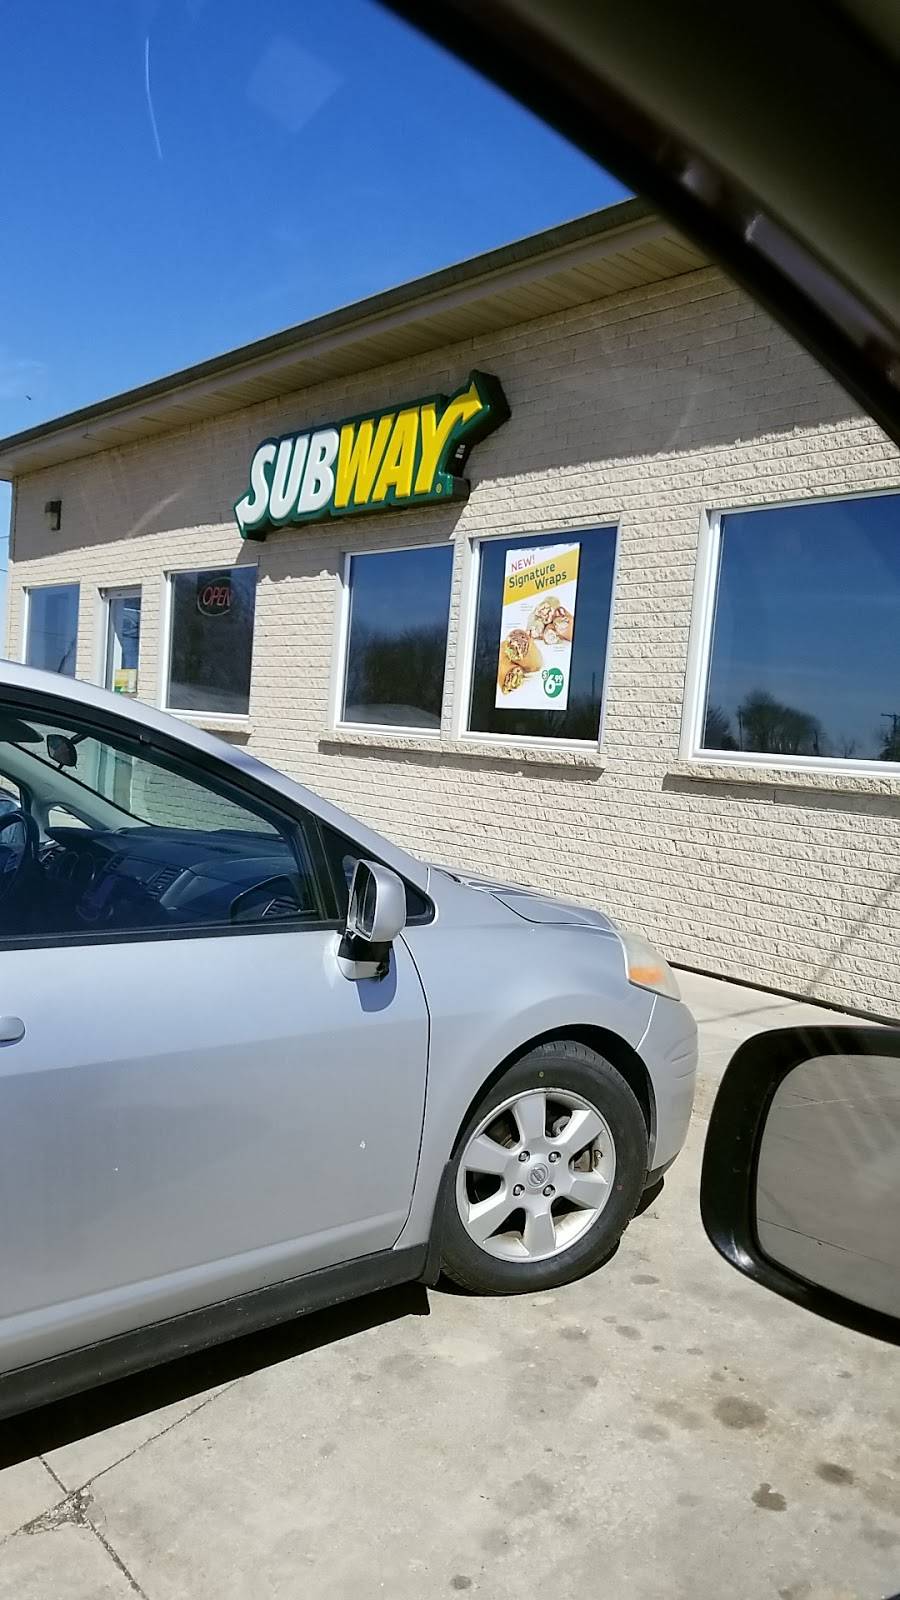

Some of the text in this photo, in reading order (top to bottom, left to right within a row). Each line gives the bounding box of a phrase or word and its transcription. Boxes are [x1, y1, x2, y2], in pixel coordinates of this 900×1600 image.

[234, 382, 482, 529] SUBWAY
[511, 554, 535, 573] NEW!
[508, 563, 556, 589] Signature
[534, 571, 567, 590] Wraps
[203, 586, 233, 607] OPEN
